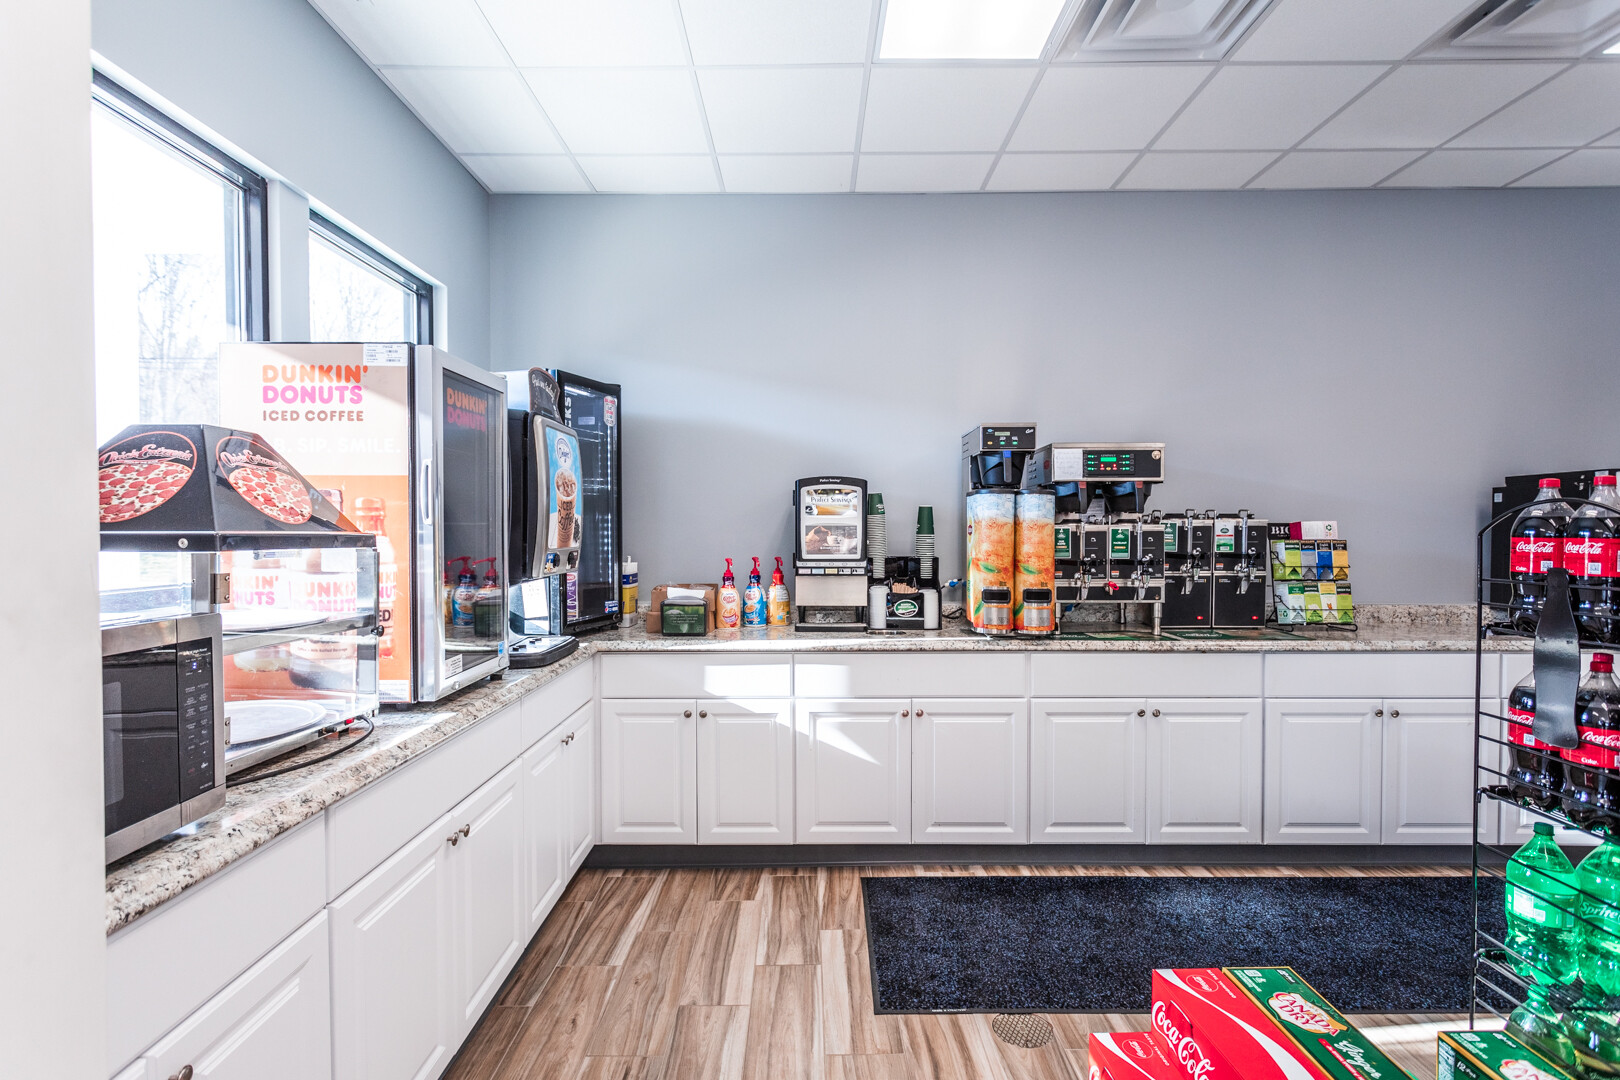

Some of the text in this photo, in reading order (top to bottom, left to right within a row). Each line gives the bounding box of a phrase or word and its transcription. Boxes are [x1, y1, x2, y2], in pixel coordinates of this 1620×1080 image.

[262, 364, 368, 383] DUNKIN'
[262, 385, 363, 404] DONUTS
[262, 409, 364, 421] ICED COFFEE
[447, 406, 486, 432] DONUTS
[1516, 541, 1556, 553] Coca-Cola
[1565, 541, 1605, 554] Coca-Cola
[1581, 901, 1619, 921] Sprite
[1273, 991, 1340, 1036] CANADA
[1278, 1003, 1315, 1026] DRY
[1334, 1040, 1382, 1079] Ginger
